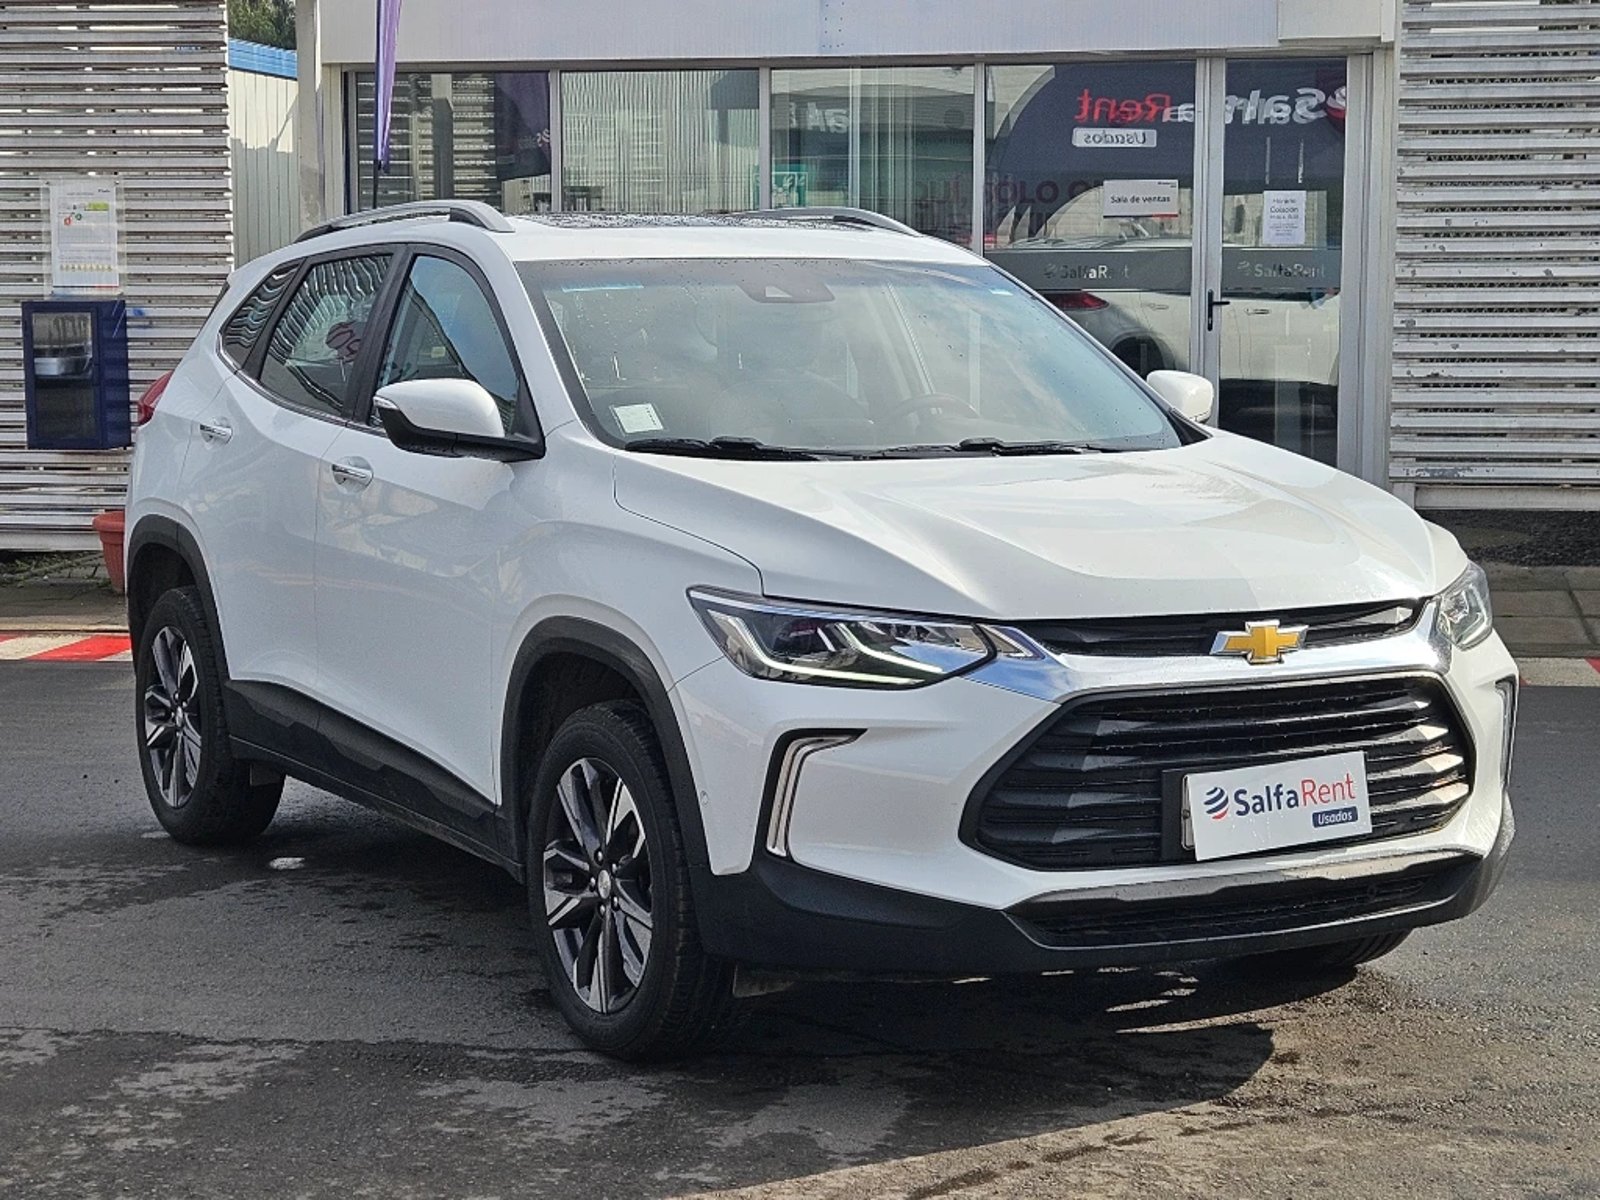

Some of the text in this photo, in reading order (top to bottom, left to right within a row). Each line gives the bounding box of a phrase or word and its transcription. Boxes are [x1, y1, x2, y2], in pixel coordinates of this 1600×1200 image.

[1110, 194, 1171, 204] Sala de ventas
[1233, 773, 1357, 816] SalfaRent
[1317, 810, 1353, 826] Usados
